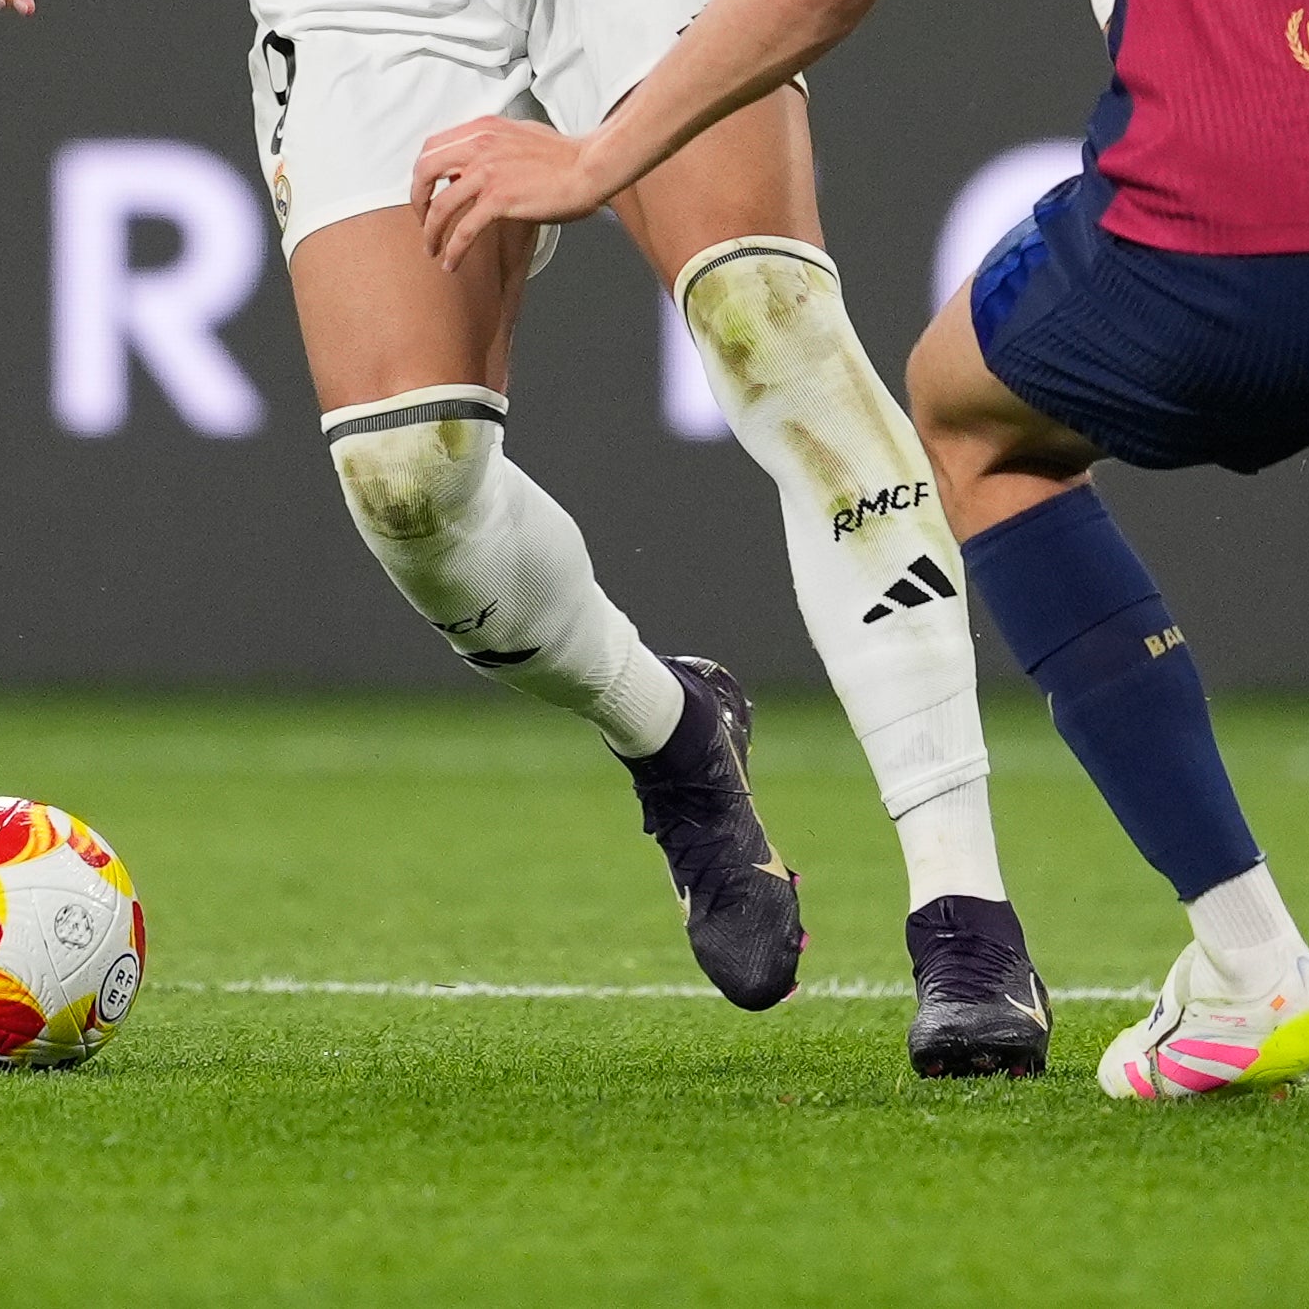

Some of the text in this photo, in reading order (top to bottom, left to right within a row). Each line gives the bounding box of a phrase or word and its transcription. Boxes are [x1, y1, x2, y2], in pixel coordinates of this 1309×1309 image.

[833, 482, 929, 542] RMCF
[115, 969, 134, 988] RF
[107, 989, 128, 1009] EF
